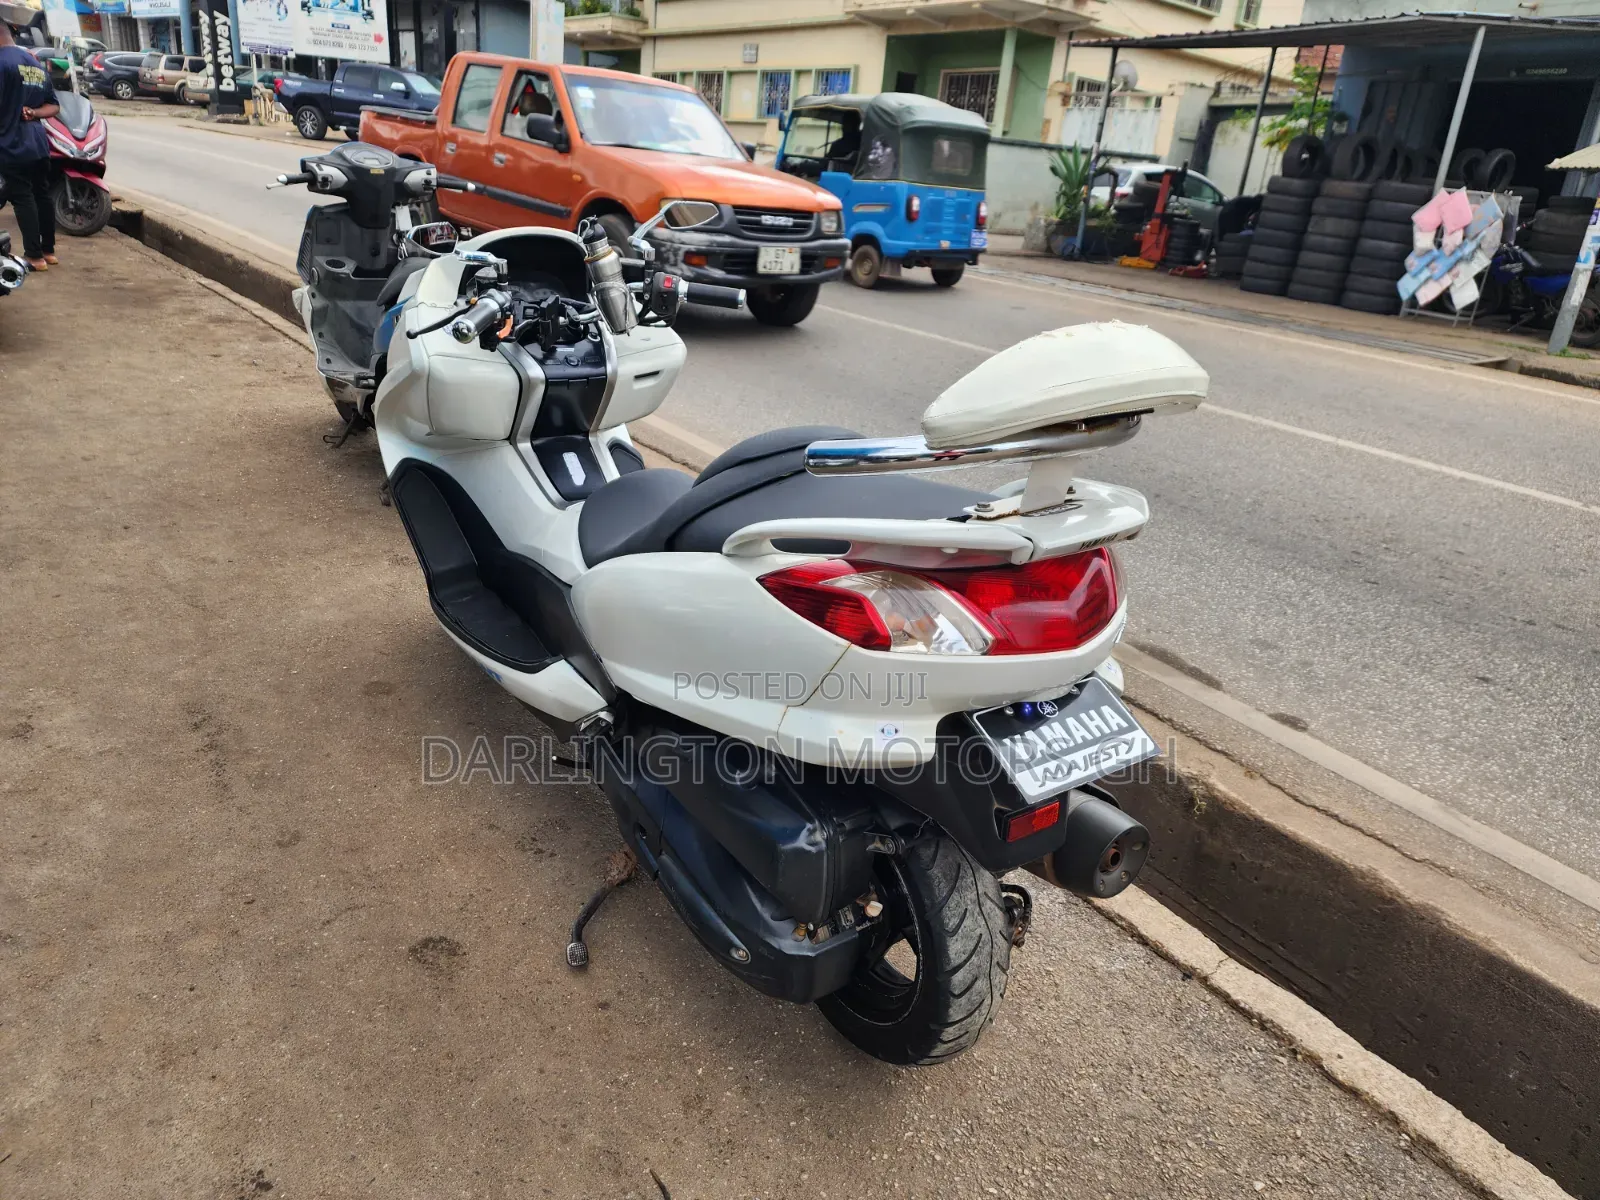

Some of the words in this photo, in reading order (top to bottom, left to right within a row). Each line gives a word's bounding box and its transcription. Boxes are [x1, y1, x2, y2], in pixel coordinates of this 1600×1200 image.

[213, 10, 235, 91] betway
[1002, 704, 1129, 761] YAMAHA
[1038, 737, 1137, 788] MAJESTY
